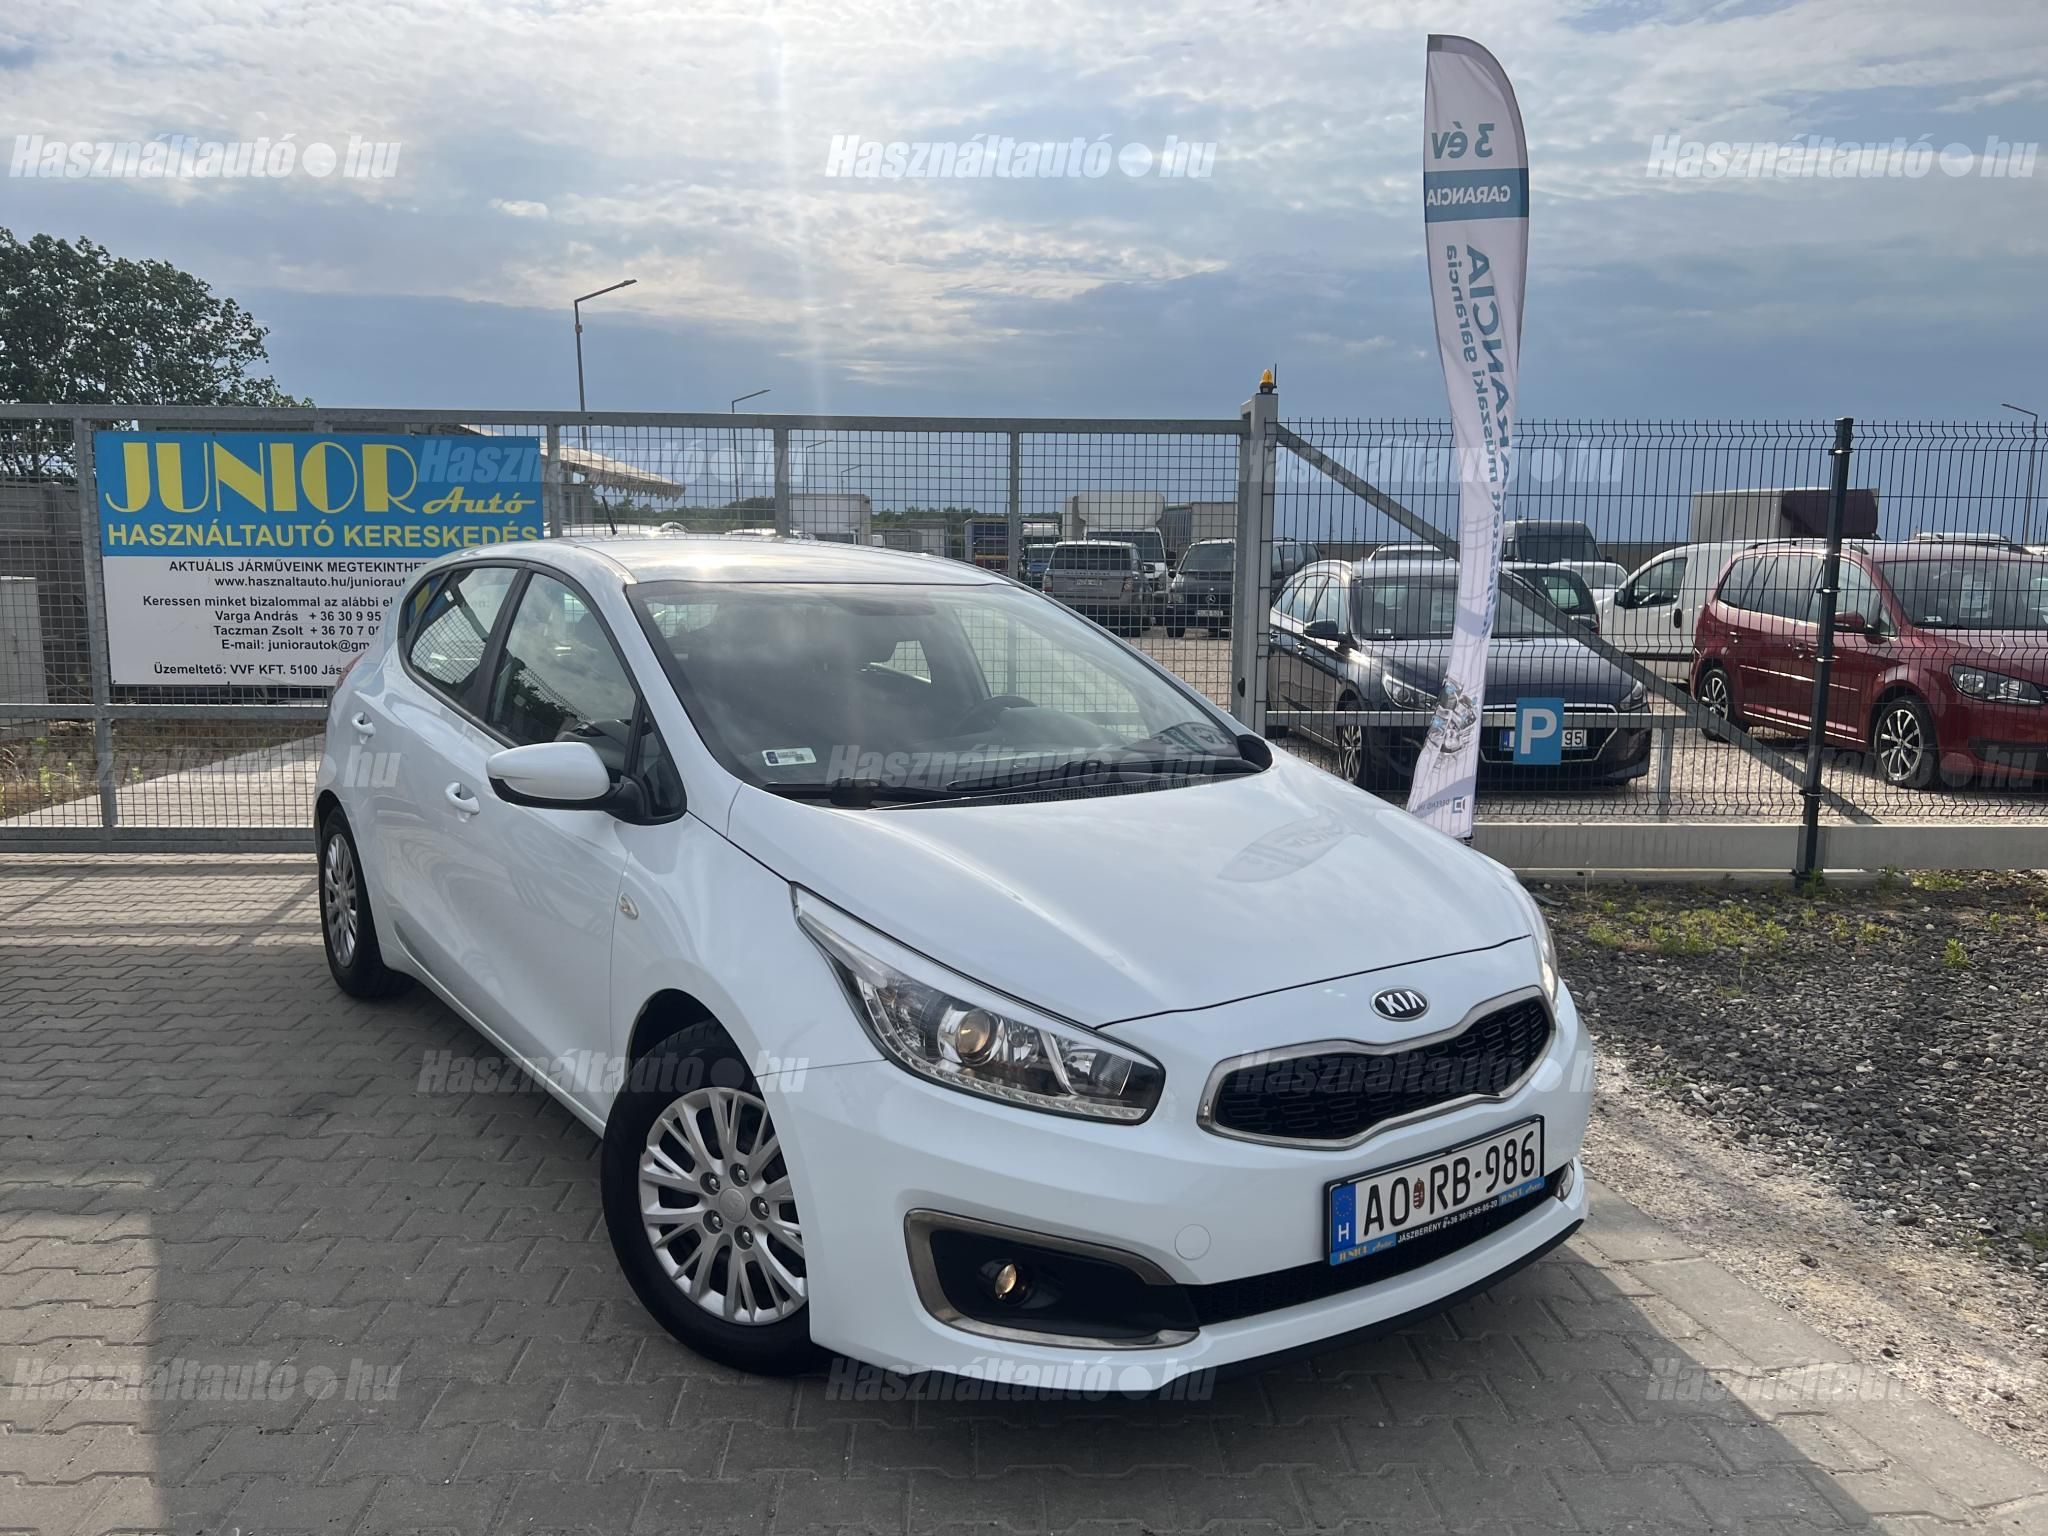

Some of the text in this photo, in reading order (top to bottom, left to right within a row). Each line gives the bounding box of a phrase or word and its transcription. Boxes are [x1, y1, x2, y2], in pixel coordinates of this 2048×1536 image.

[105, 442, 536, 514] JUNIOR Autó
[108, 519, 539, 548] HASZNÁLTAUTÓ KERESKEDÉS
[169, 558, 428, 573] AKTUÁLIS JÁRMŰVEINK MEGTEKINTHE
[143, 595, 201, 606] Keressen
[204, 595, 246, 607] minket
[250, 596, 320, 607] bizalommal
[324, 598, 338, 607] az
[341, 596, 379, 607] alábbi
[215, 610, 251, 623] Varga
[254, 610, 298, 621] András
[320, 611, 335, 621] 36
[338, 611, 352, 621] 30
[355, 611, 363, 621] 9
[366, 611, 382, 621] 95
[213, 625, 268, 636] Taczman
[271, 625, 304, 636] Zsolt
[321, 626, 336, 636] 36
[339, 626, 353, 636] 70
[356, 626, 364, 636] 7
[368, 626, 380, 636] 0
[222, 639, 370, 653] E-mail: juniorautok@gm
[154, 661, 345, 675] Üzemeltető: VVF KFT. 5100 Jás
[1520, 708, 1557, 755] P
[1379, 991, 1425, 1014] KIA
[1429, 1130, 1535, 1215] RB-986
[1338, 1222, 1350, 1243] H
